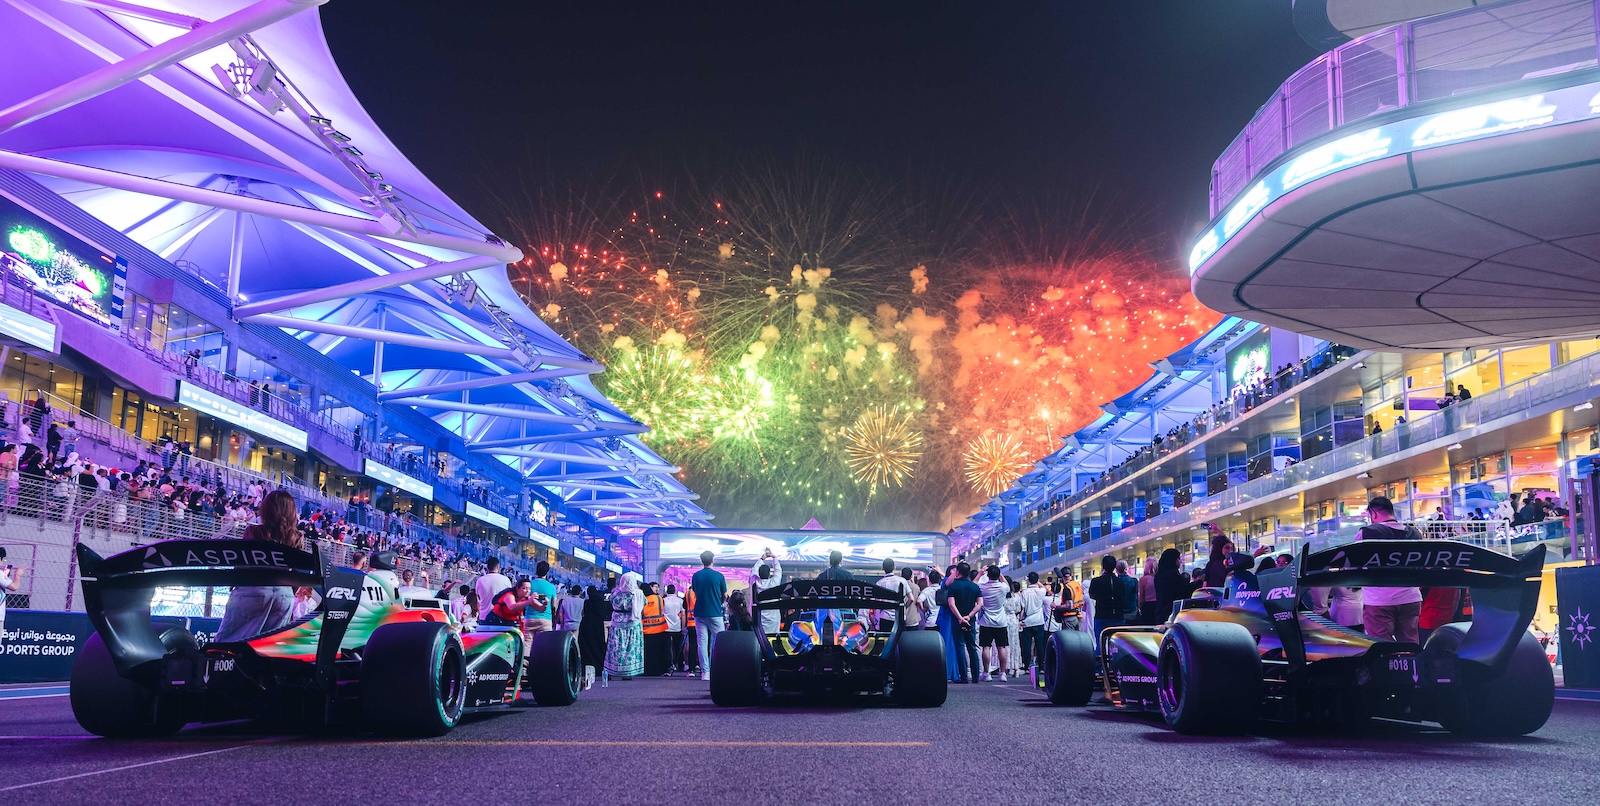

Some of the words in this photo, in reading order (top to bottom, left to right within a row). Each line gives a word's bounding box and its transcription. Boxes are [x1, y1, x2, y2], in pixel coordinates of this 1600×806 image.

[185, 550, 288, 567] ASPIRE
[1364, 551, 1474, 567] ASPIRE
[326, 586, 357, 600] A2RL
[806, 586, 874, 597] ASPIRE
[1266, 586, 1296, 600] A2RL
[46, 630, 76, 642] مجموعة
[6, 644, 40, 655] PORTS
[42, 646, 74, 656] GROUP
[214, 660, 234, 672] #008
